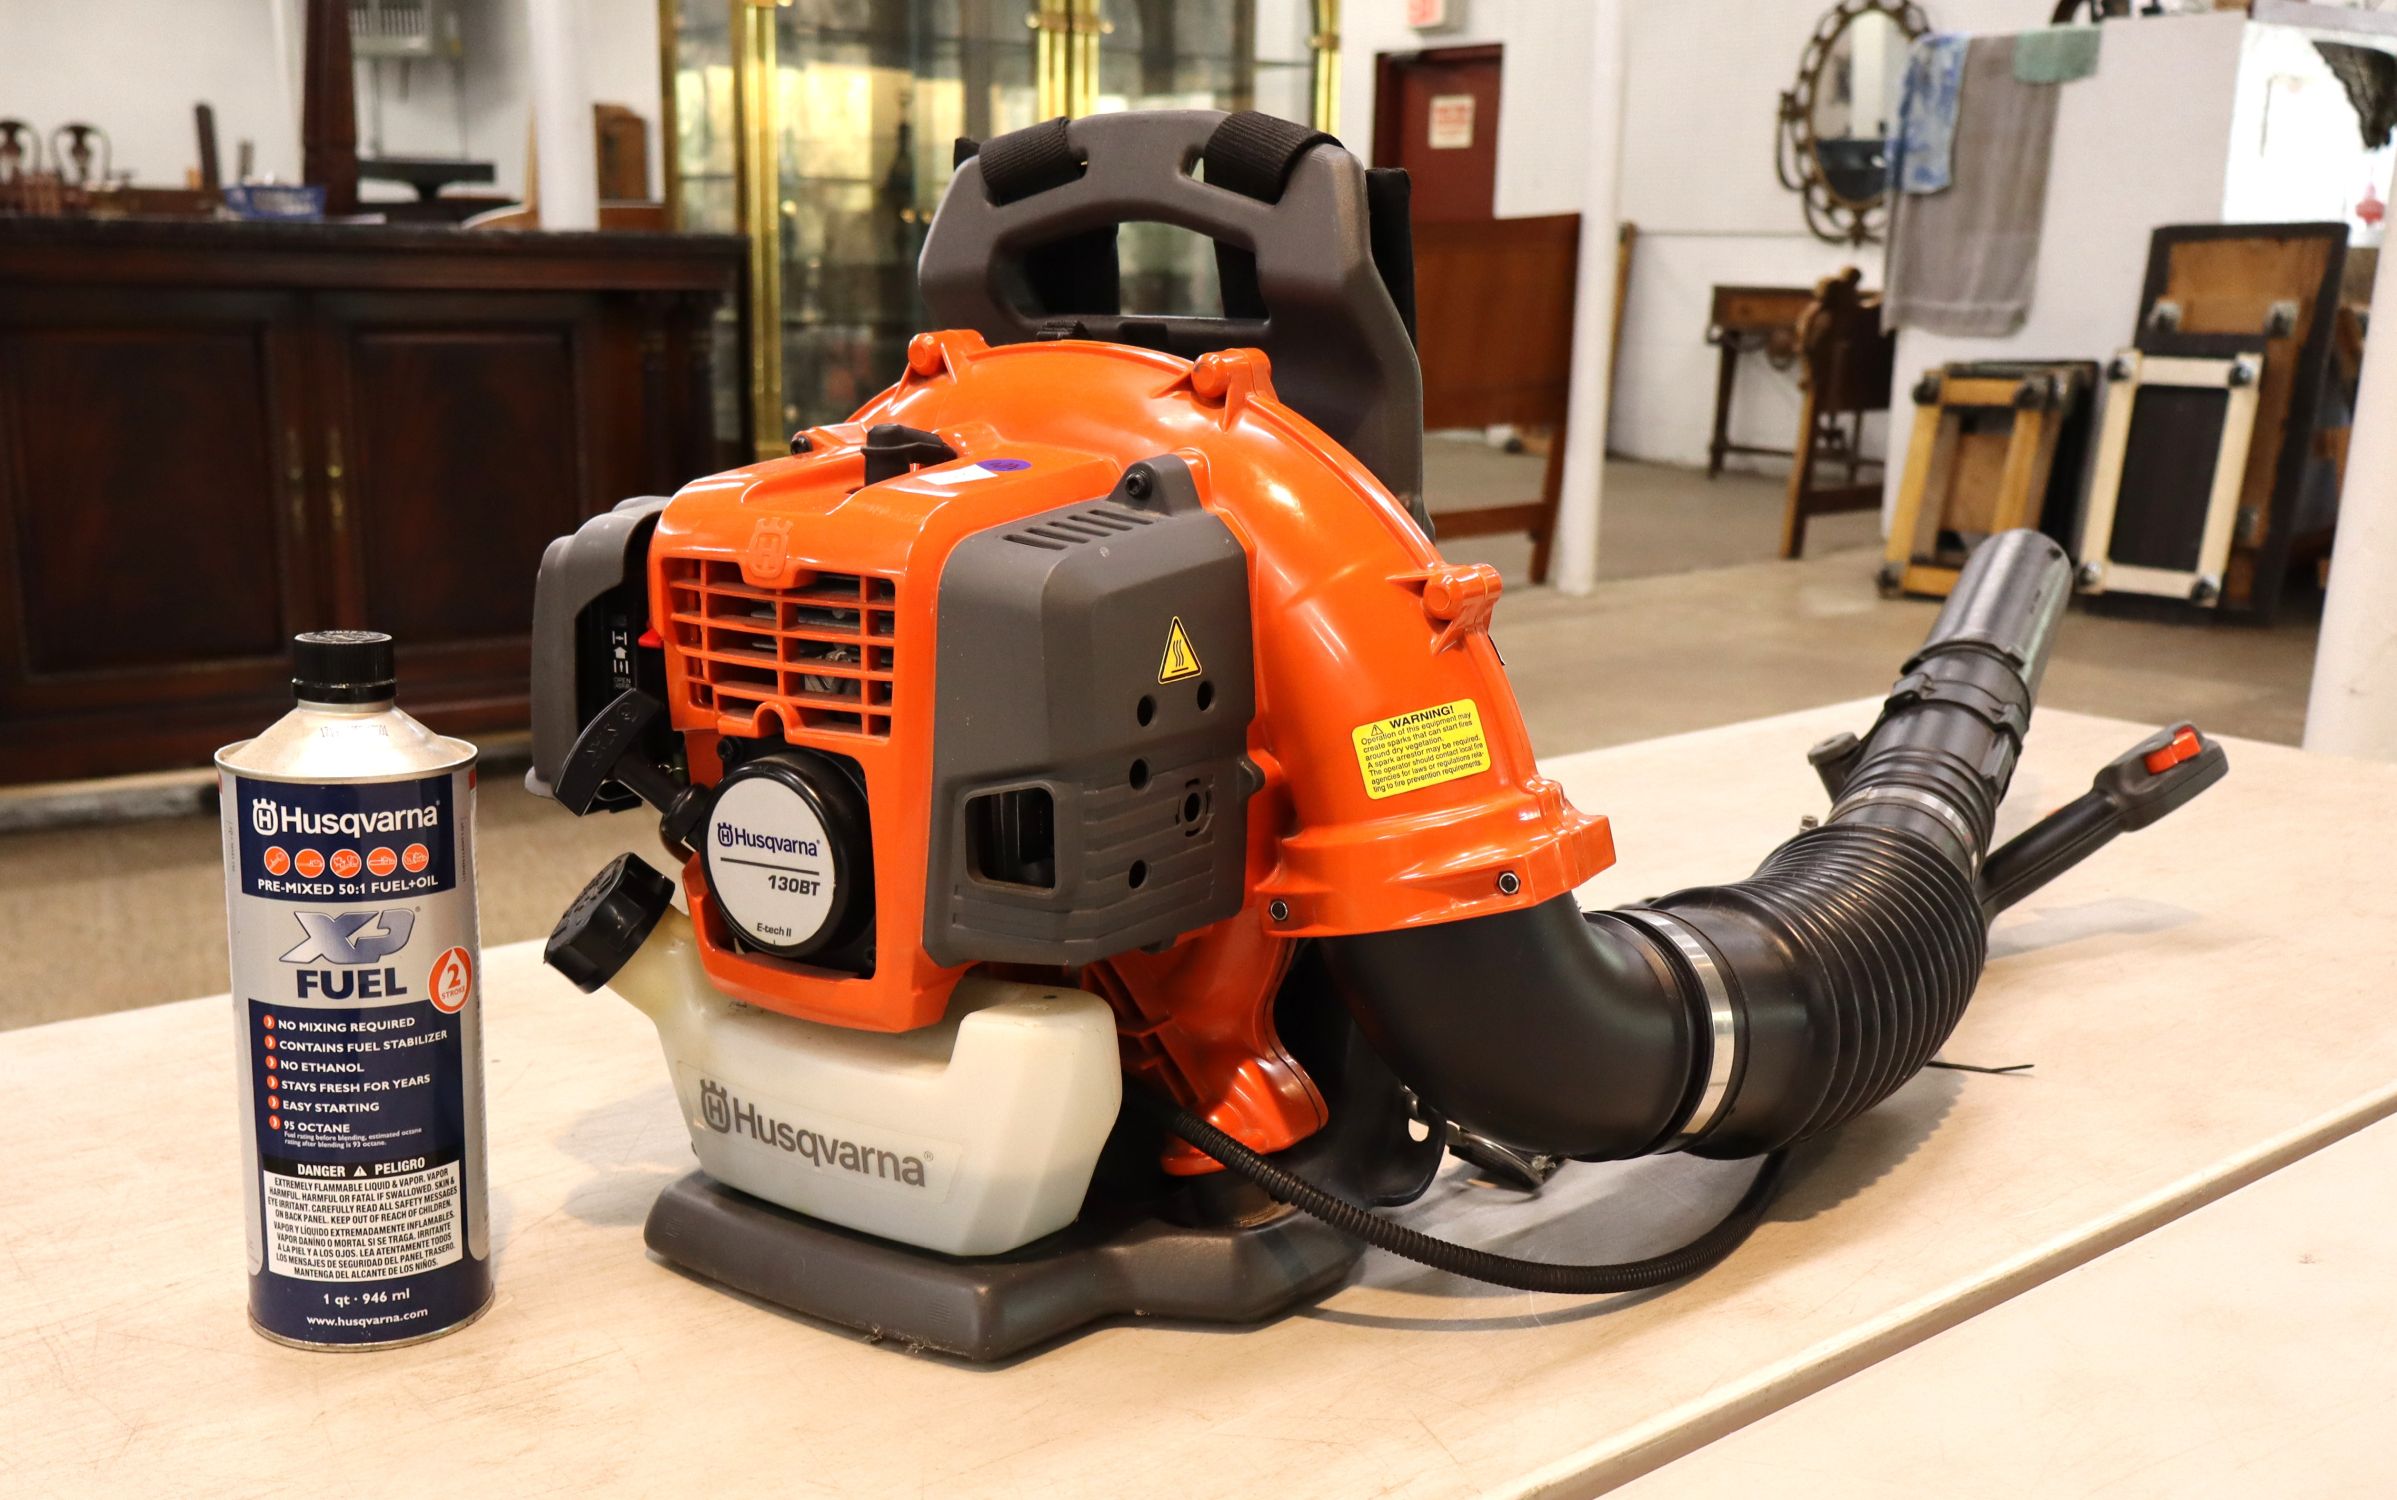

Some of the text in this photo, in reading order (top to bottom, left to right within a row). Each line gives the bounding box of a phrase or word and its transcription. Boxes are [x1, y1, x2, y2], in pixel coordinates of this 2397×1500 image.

[1390, 705, 1454, 728] WARNING!
[1361, 731, 1396, 745] Operation
[1407, 723, 1419, 733] this
[1422, 715, 1456, 730] equipment
[1363, 720, 1472, 753] create sparks that can start fires
[1365, 750, 1390, 761] around
[1405, 736, 1444, 750] vegetation.
[1375, 757, 1394, 768] spark
[1397, 750, 1423, 759] arrestor
[1426, 746, 1440, 755] may
[1453, 733, 1480, 746] required.
[1369, 769, 1382, 777] The
[1384, 762, 1411, 774] operator
[1413, 755, 1434, 765] should
[1436, 748, 1458, 759] contact
[1372, 772, 1400, 785] agencies
[1437, 755, 1470, 767] regulations
[1395, 779, 1405, 787] fire
[1407, 771, 1440, 785] prevention
[1442, 760, 1482, 775] requirements.
[281, 806, 438, 838] Husqvarna
[735, 827, 818, 857] Husqvarna
[258, 875, 438, 895] PRE-MIXED 50:1 FUEL+OIL
[768, 875, 820, 896] 130BT
[279, 908, 415, 965] XP
[757, 923, 784, 936] E-tech
[297, 968, 407, 999] FUEL
[448, 963, 460, 989] 2
[278, 1018, 415, 1032] NO MIXING REQUIRED
[280, 1030, 447, 1053] CONTAINS FUEL STABILIZER
[281, 1060, 364, 1072] NO ETHANOL
[282, 1074, 430, 1092] STAYS FRESH FOR YEARS
[283, 1100, 379, 1113] EASY STARTING
[284, 1121, 350, 1133] 95 OCTANE
[368, 1131, 400, 1139] estimated
[401, 1128, 422, 1136] octane
[318, 1141, 344, 1149] blending
[733, 1097, 925, 1187] Husqvarna
[298, 1157, 425, 1177] DANGER PELIGRO
[269, 1176, 455, 1203] HARMFUL. HARMFUL OR FATAL IF SWALLOWED. SKIN &
[275, 1177, 312, 1191] EXTREMELY
[314, 1182, 363, 1191] FLAMMABLE
[392, 1180, 397, 1188] &
[399, 1174, 425, 1187] VAPOR.
[427, 1168, 448, 1181] VAPOR
[268, 1196, 278, 1206] EYE
[312, 1204, 354, 1213] CAREFULLY
[356, 1203, 377, 1213] READ
[379, 1202, 393, 1211] ALL
[395, 1197, 422, 1209] SAFETY
[424, 1186, 457, 1203] MESSAGES
[276, 1209, 283, 1218] ON
[285, 1212, 302, 1221] BACK
[304, 1214, 329, 1223] PANEL.
[331, 1216, 350, 1224] KEEP
[353, 1215, 368, 1224] OUT
[370, 1214, 380, 1223] OF
[381, 1211, 406, 1222] REACH
[408, 1208, 417, 1217] OF
[274, 1221, 293, 1232] VAPOR
[331, 1223, 405, 1237] EXTREMADAMENTE
[277, 1232, 297, 1244] VAPOR
[328, 1239, 332, 1247] O
[334, 1238, 366, 1247] MORTAL
[368, 1238, 375, 1246] SI
[377, 1237, 387, 1245] SE
[388, 1233, 416, 1244] TRAGA.
[418, 1222, 451, 1238] IRRITANTE
[292, 1246, 305, 1255] PIEL
[307, 1248, 312, 1256] Y
[320, 1249, 333, 1257] LOS
[335, 1249, 358, 1257] OJOS.
[360, 1248, 374, 1257] LEA
[377, 1240, 429, 1254] ATENTAMENTE
[431, 1232, 451, 1245] TODOS
[276, 1253, 287, 1262] LOS
[289, 1256, 325, 1268] MENSAJES
[327, 1260, 336, 1268] DE
[339, 1259, 382, 1268] SEGURIDAD
[385, 1257, 398, 1266] DEL
[400, 1252, 423, 1262] PANEL
[294, 1267, 334, 1279] MANTENGA
[336, 1270, 349, 1279] DEL
[351, 1268, 386, 1278] ALCANTE
[388, 1265, 398, 1275] DE
[400, 1263, 413, 1273] LOS
[324, 1288, 409, 1308] 1 qt 946 ml
[307, 1307, 428, 1328] www.husqvarna.com
